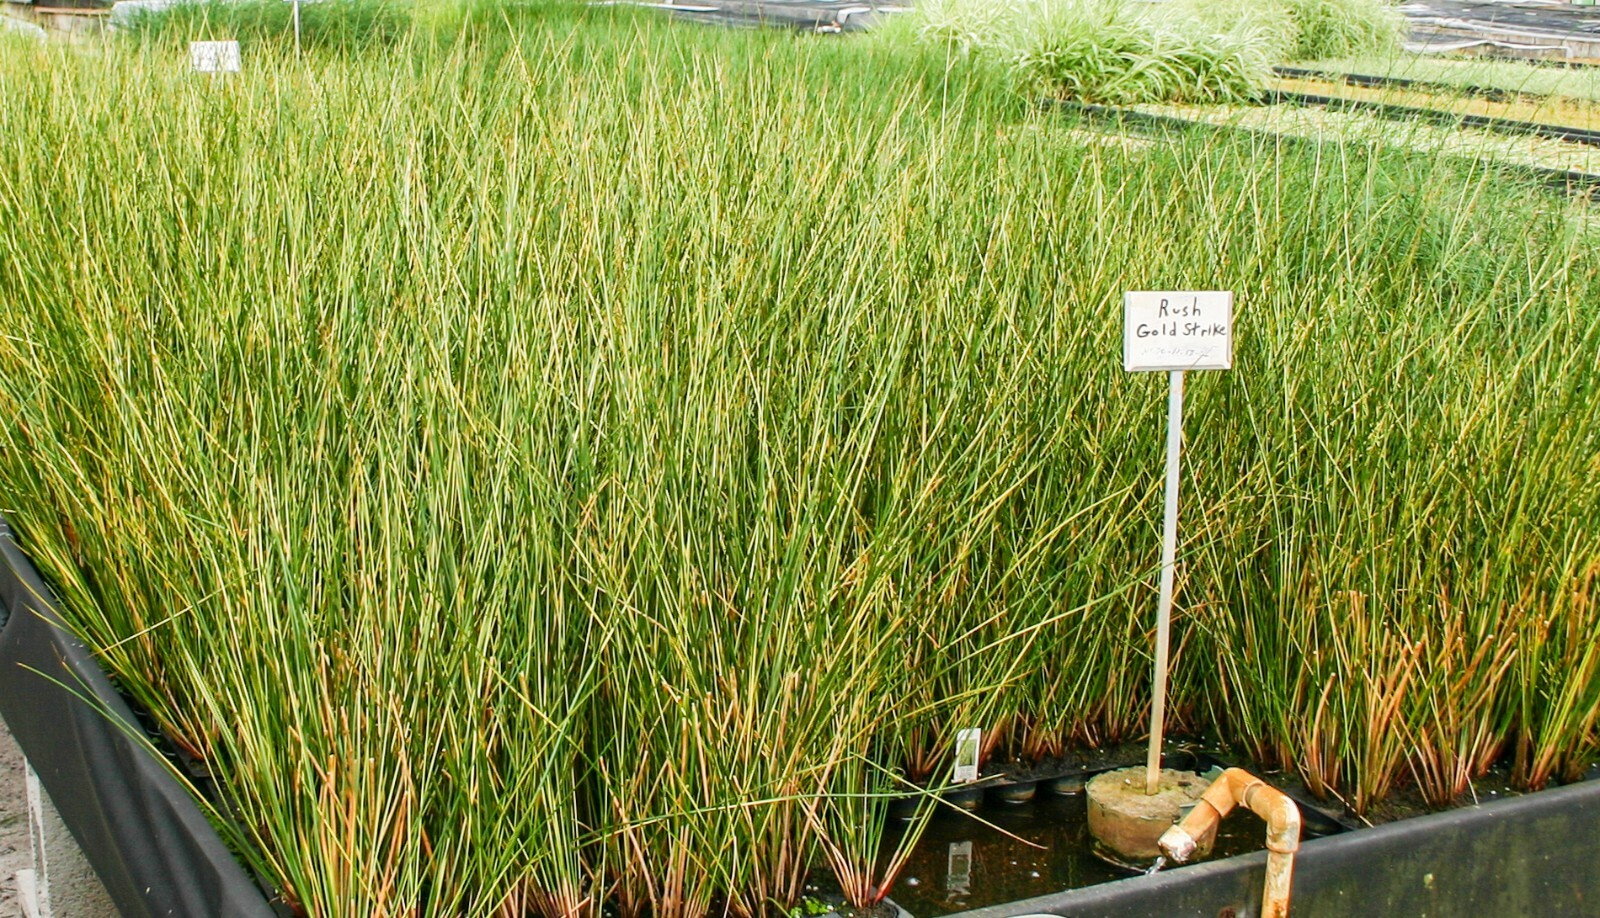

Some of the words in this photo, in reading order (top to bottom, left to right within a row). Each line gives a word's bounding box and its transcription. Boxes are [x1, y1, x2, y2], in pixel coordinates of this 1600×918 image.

[1158, 296, 1202, 318] Rush
[1136, 321, 1177, 338] Gold
[1182, 322, 1227, 337] Strike
